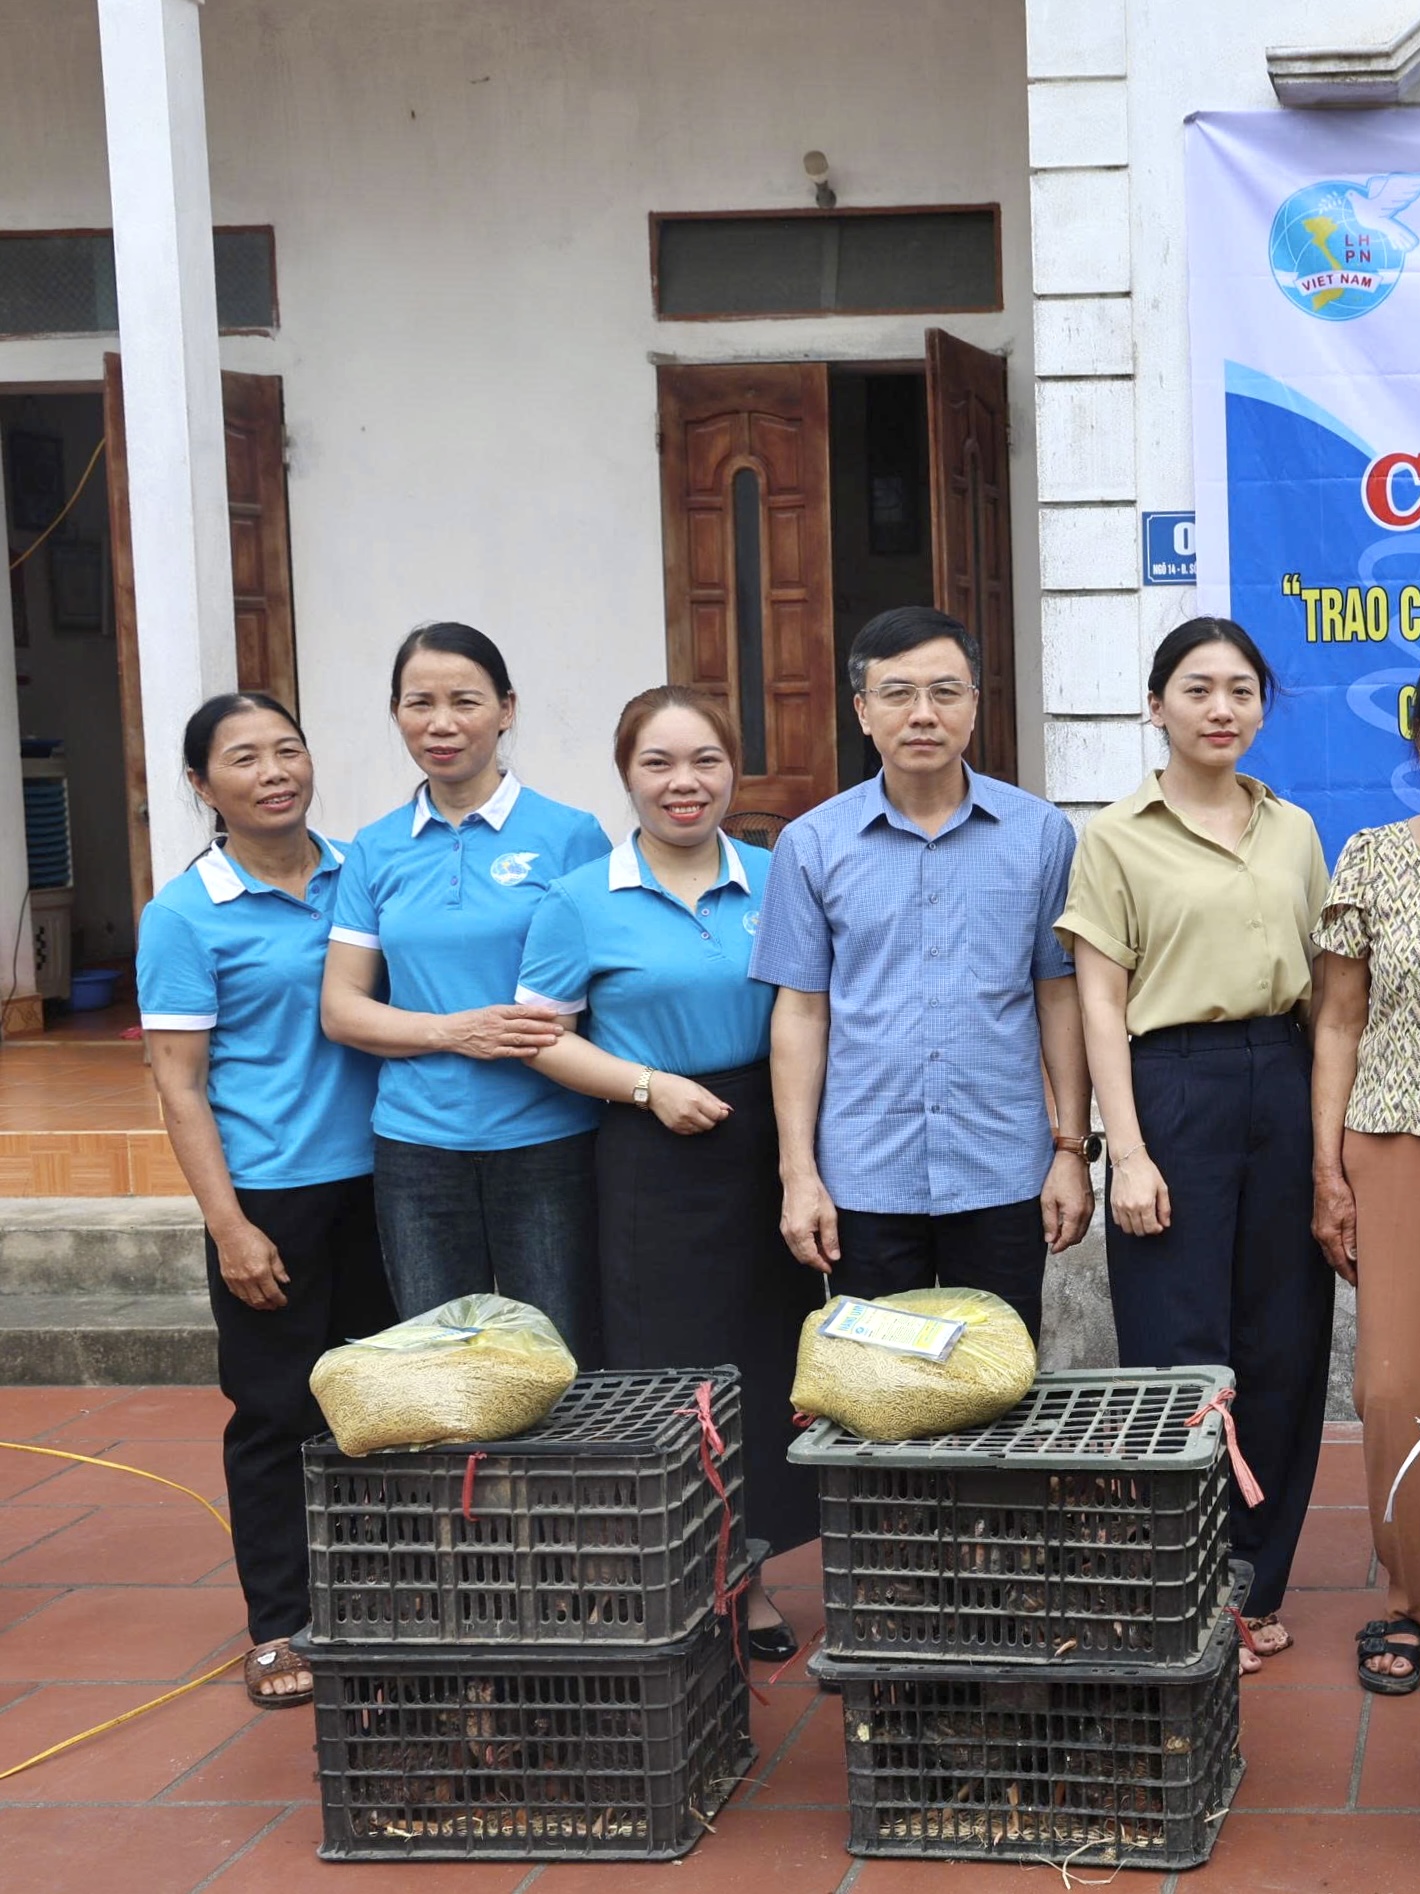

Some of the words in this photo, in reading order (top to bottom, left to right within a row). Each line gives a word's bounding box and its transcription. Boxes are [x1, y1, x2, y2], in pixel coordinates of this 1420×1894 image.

[1301, 274, 1334, 291] VIET
[1340, 273, 1372, 288] NAM
[1281, 573, 1389, 643] “TRAO
